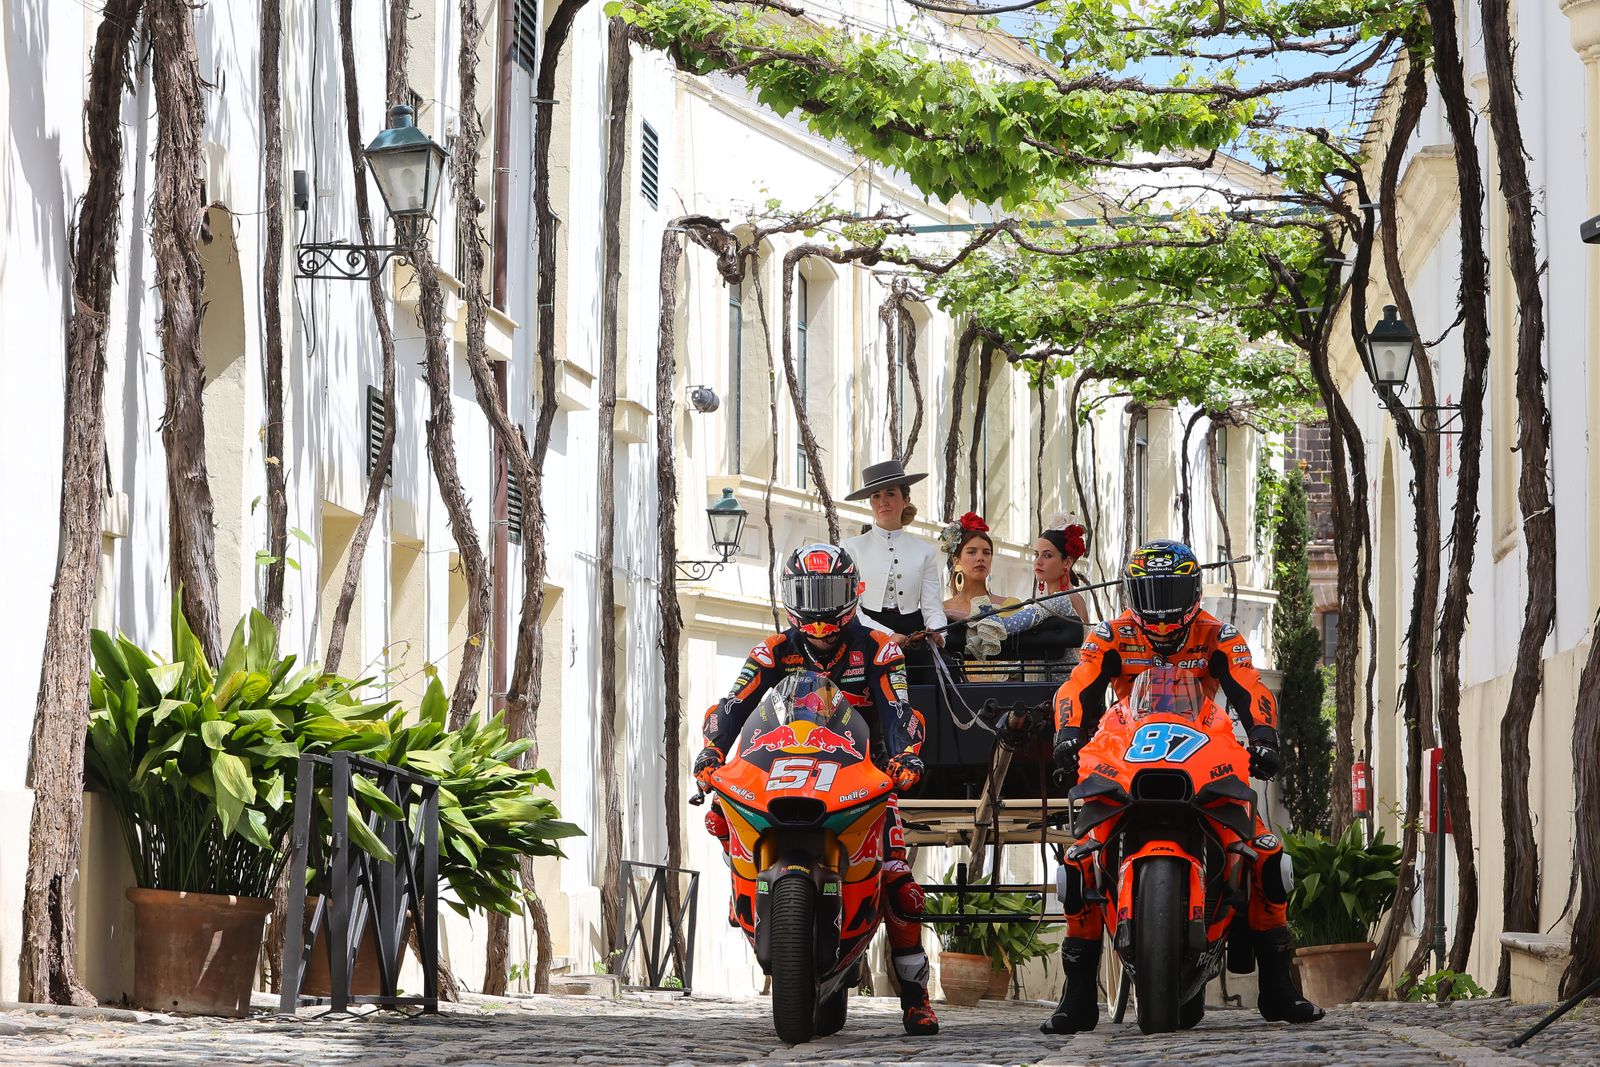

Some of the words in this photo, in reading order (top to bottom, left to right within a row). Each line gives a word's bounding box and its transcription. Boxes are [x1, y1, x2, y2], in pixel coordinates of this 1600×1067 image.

[1177, 659, 1198, 669] elf
[1124, 722, 1210, 764] 87
[765, 756, 842, 793] 51
[1095, 763, 1120, 779] KTM
[1209, 762, 1234, 780] KTM
